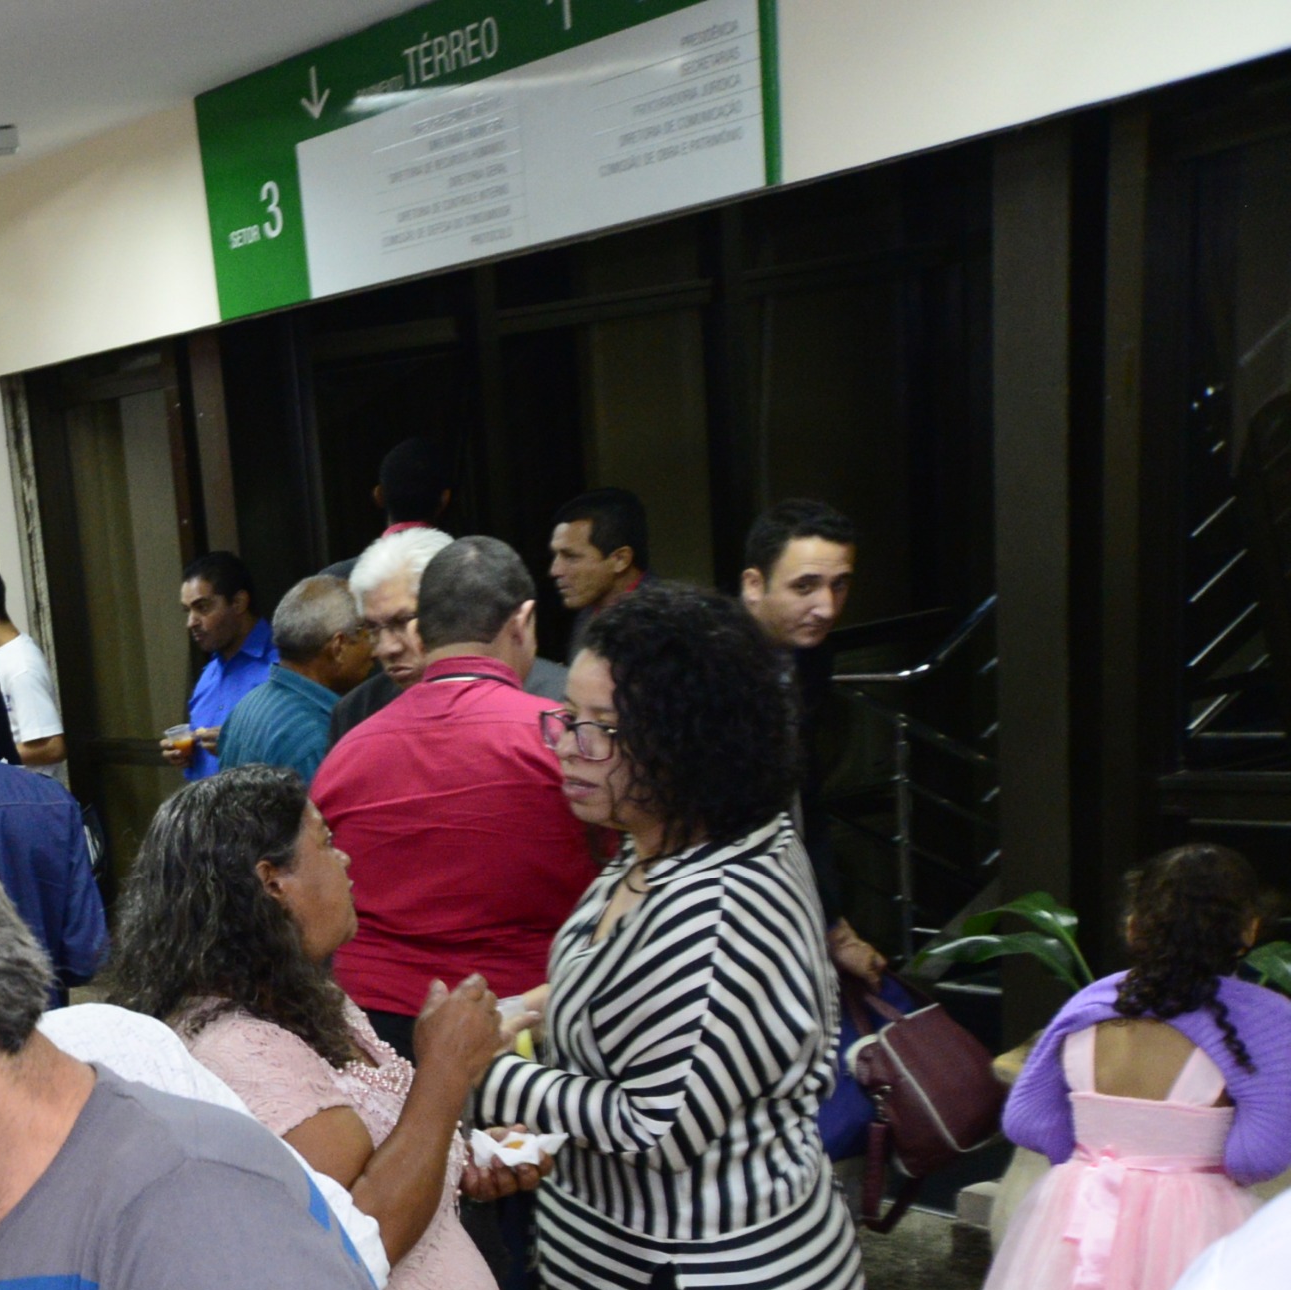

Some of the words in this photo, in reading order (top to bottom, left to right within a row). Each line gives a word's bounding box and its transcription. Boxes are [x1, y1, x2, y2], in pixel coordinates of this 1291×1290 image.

[403, 16, 499, 85] TÉRREO
[229, 224, 261, 250] SETOR
[260, 180, 283, 239] 3
